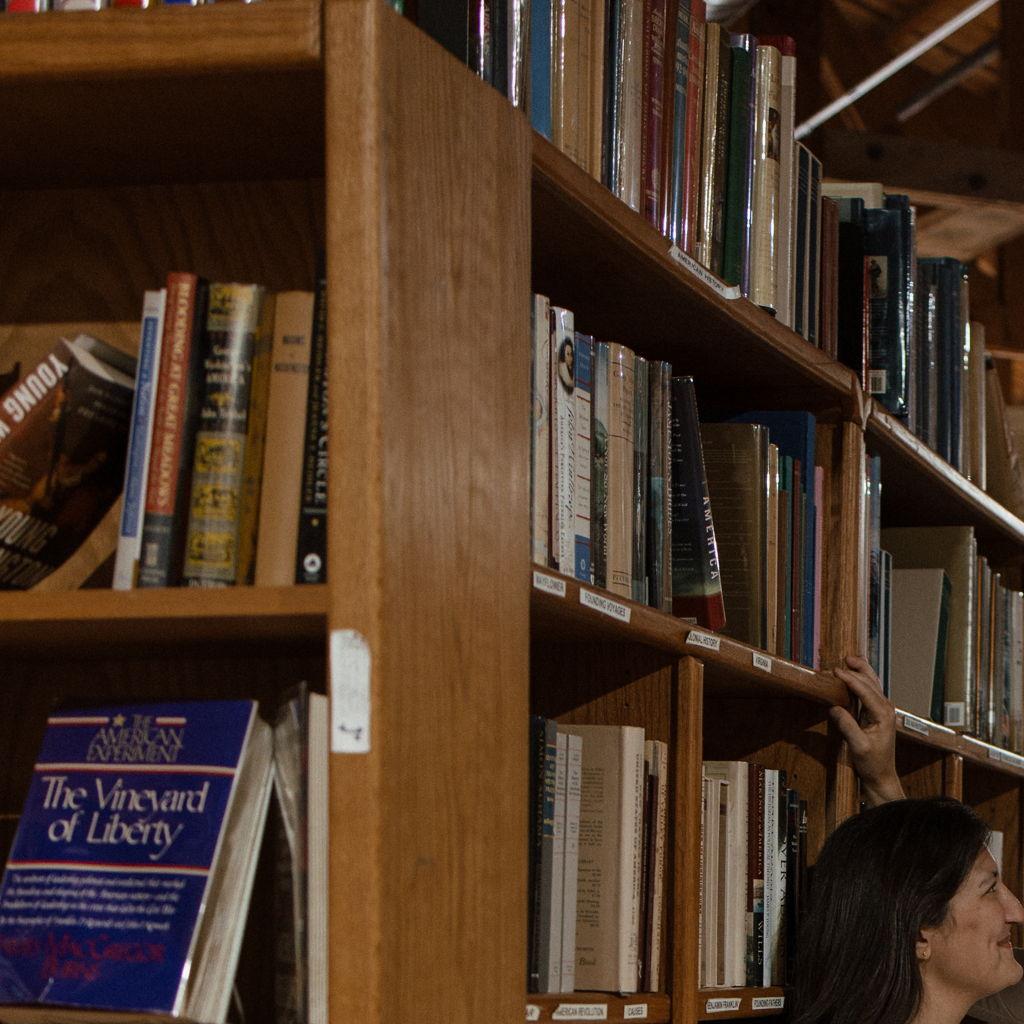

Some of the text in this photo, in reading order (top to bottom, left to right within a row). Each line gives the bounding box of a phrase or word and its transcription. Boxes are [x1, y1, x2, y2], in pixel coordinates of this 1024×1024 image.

[677, 253, 703, 277] AMERICAN
[172, 282, 191, 360] BLOODING
[3, 353, 69, 423] YOUNG
[164, 383, 180, 430] GREAT
[157, 432, 178, 508] MEADOWS
[703, 496, 719, 581] AMERICA
[584, 592, 606, 611] FOUNDING
[87, 744, 179, 762] EXPERIMENT
[94, 728, 185, 749] AMERICAN
[42, 776, 210, 815] The Vineyard
[48, 810, 185, 861] of Liberty
[577, 1007, 605, 1017] REVOLUTION
